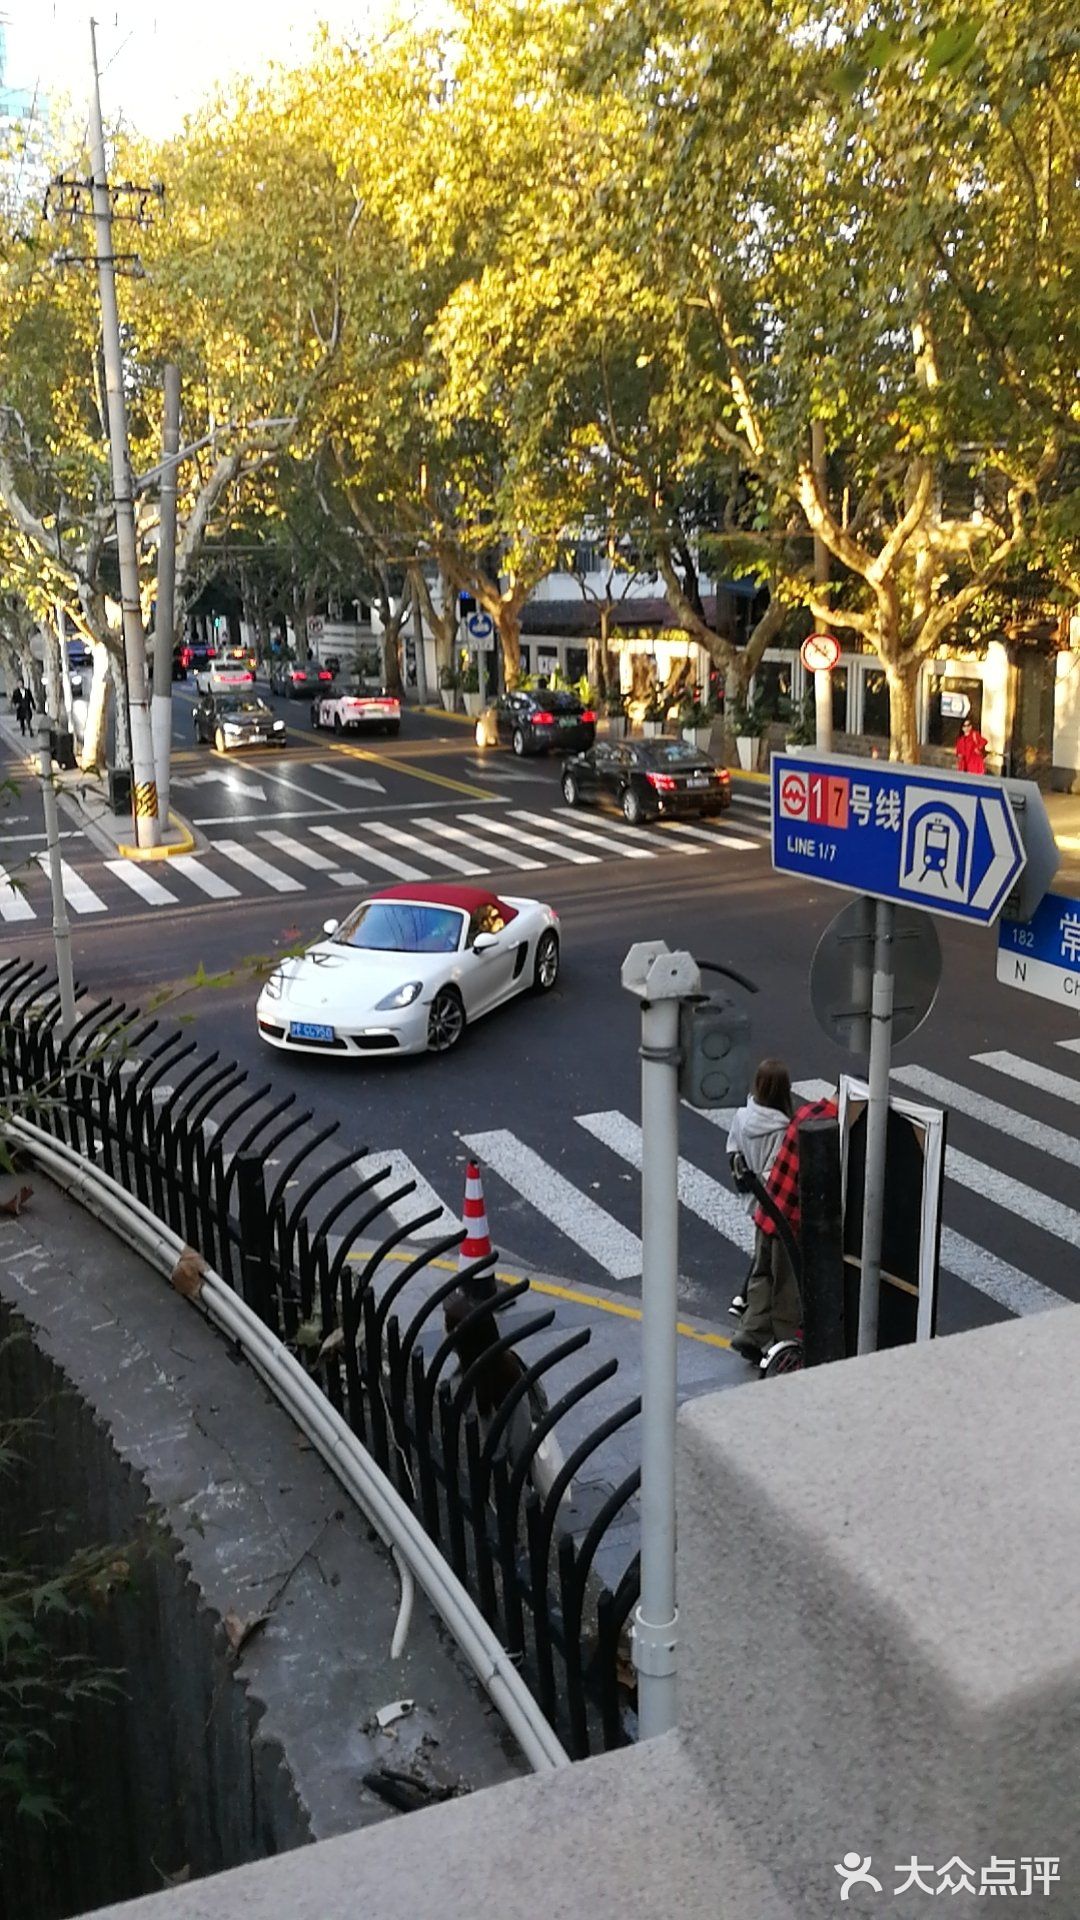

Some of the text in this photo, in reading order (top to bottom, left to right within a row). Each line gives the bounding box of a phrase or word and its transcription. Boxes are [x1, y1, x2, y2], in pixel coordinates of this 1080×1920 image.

[787, 834, 837, 862] LINE 1/7
[1012, 927, 1035, 948] 182
[1014, 959, 1027, 982] N
